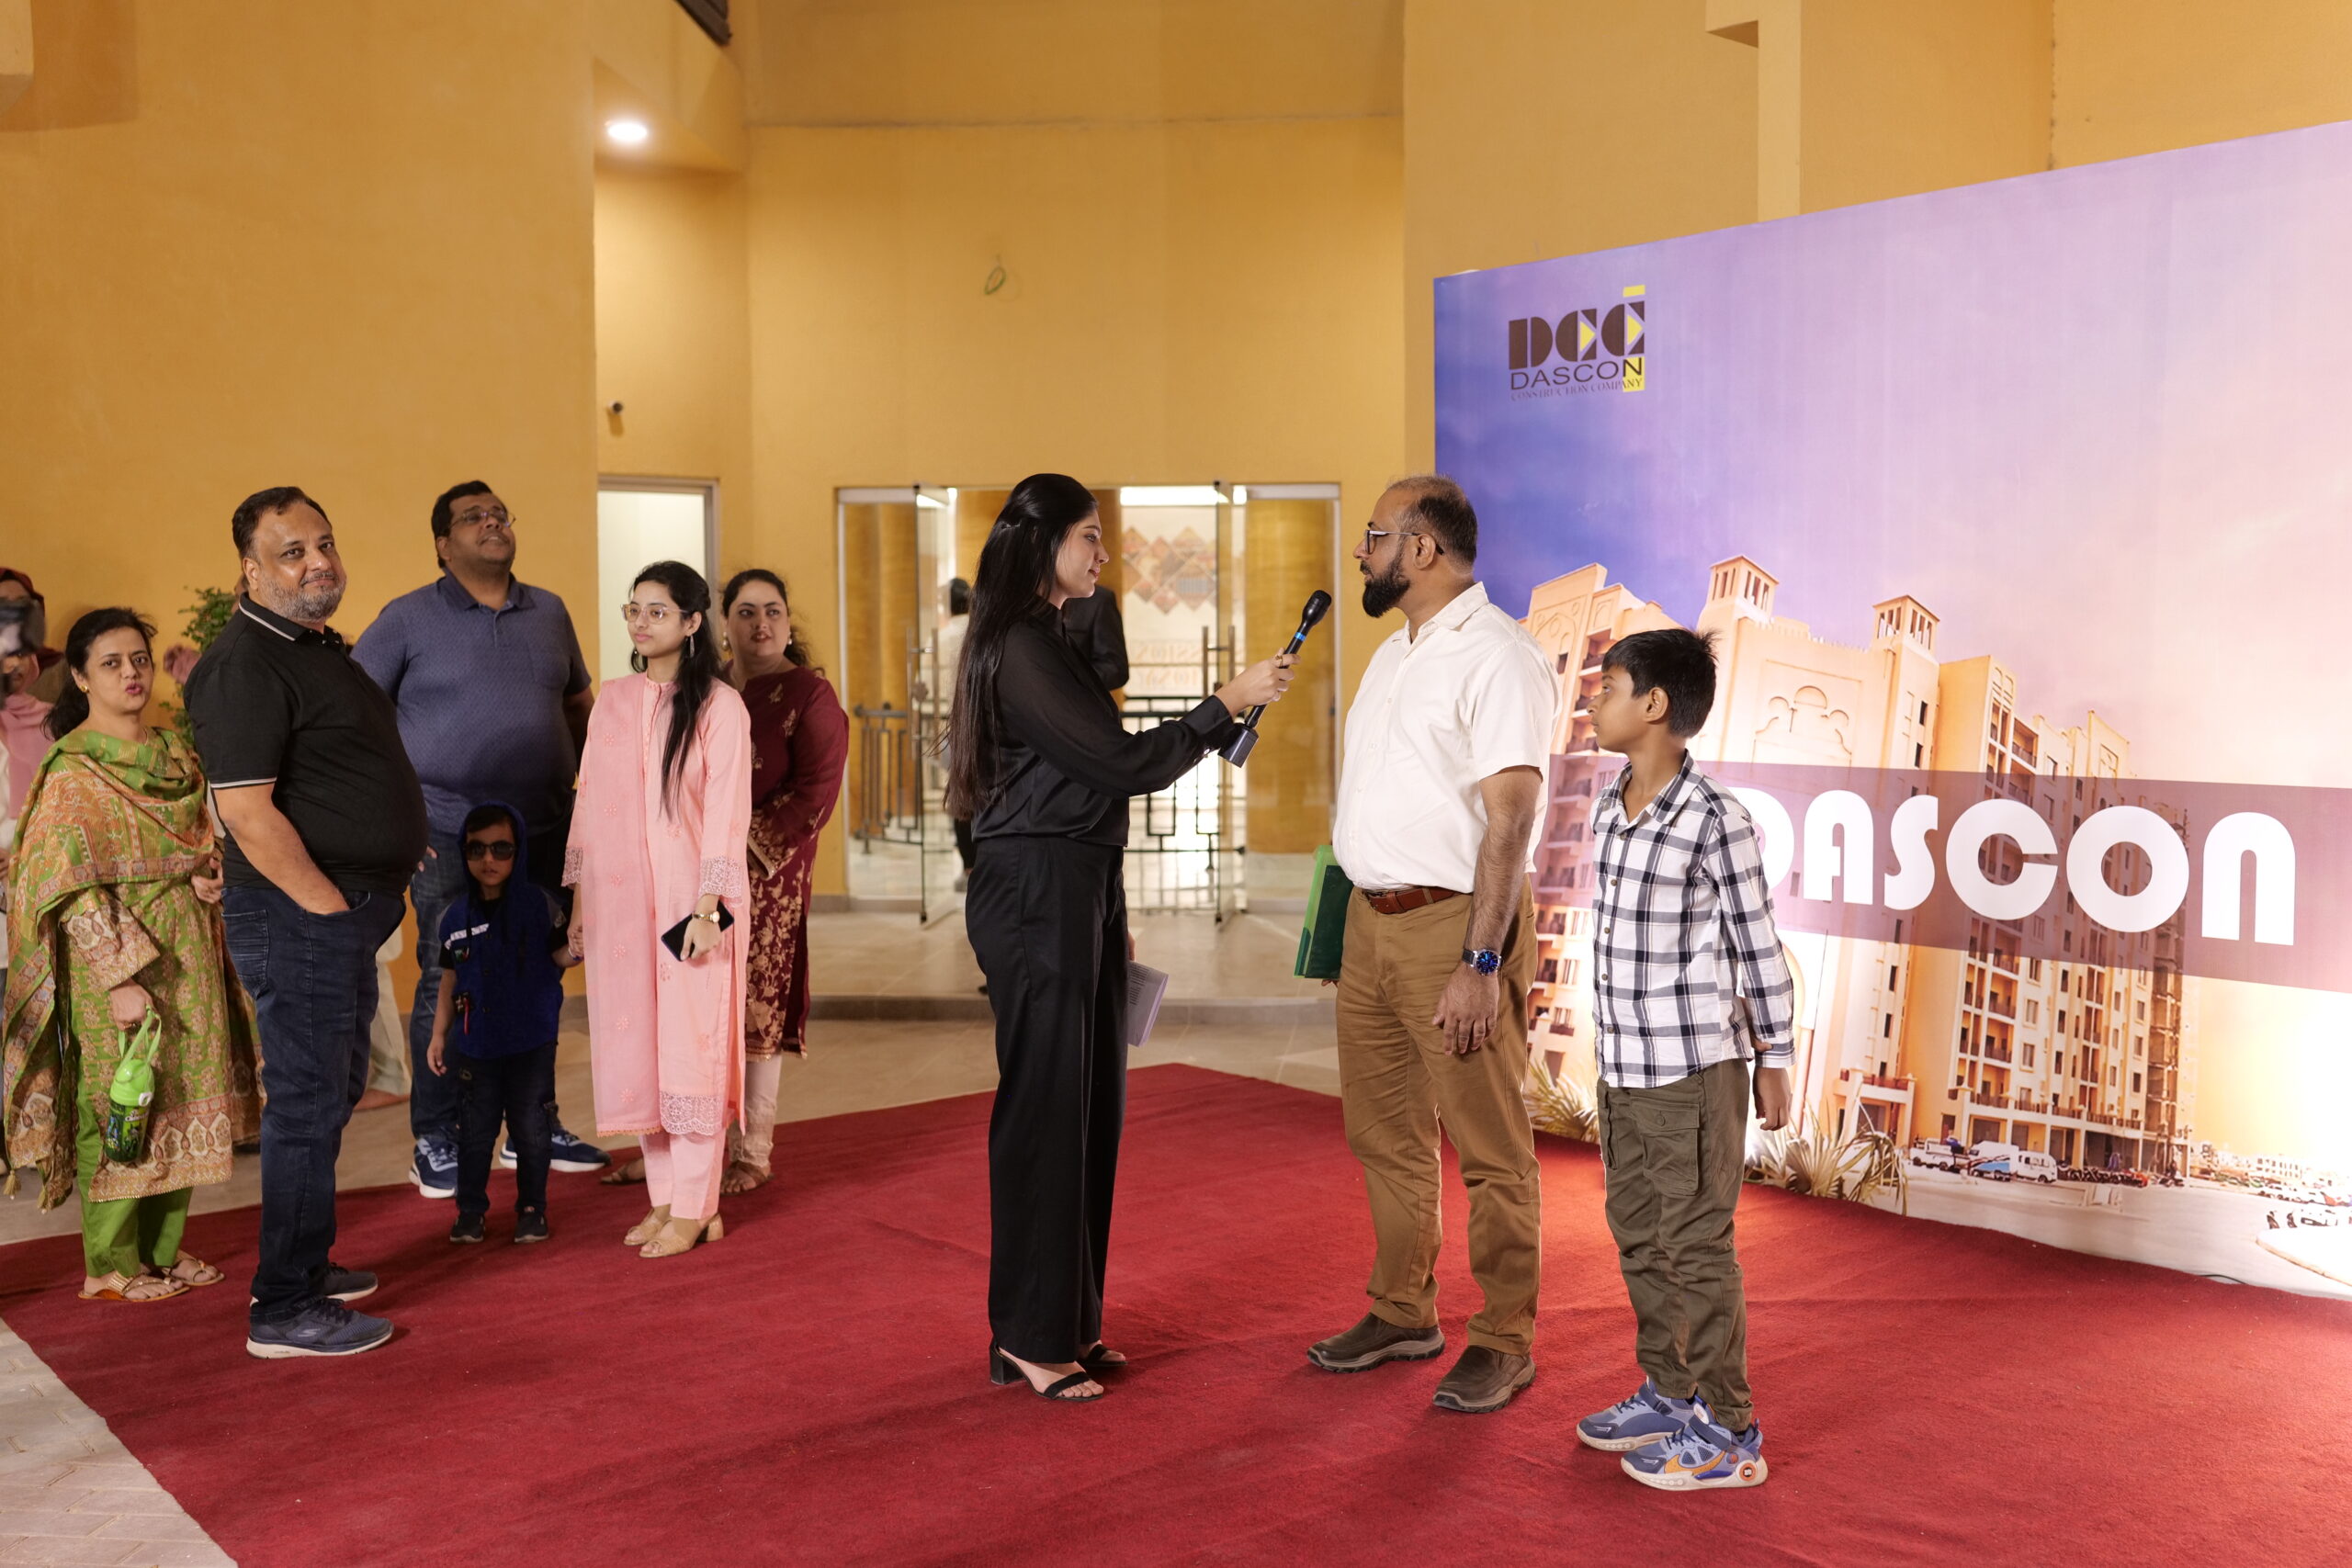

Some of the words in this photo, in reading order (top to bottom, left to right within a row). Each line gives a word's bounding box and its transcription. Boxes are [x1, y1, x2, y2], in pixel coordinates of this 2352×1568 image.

[1510, 356, 1643, 390] DASCON
[1511, 384, 1589, 401] CONSTRUCTION
[1590, 378, 1643, 393] COMPANY
